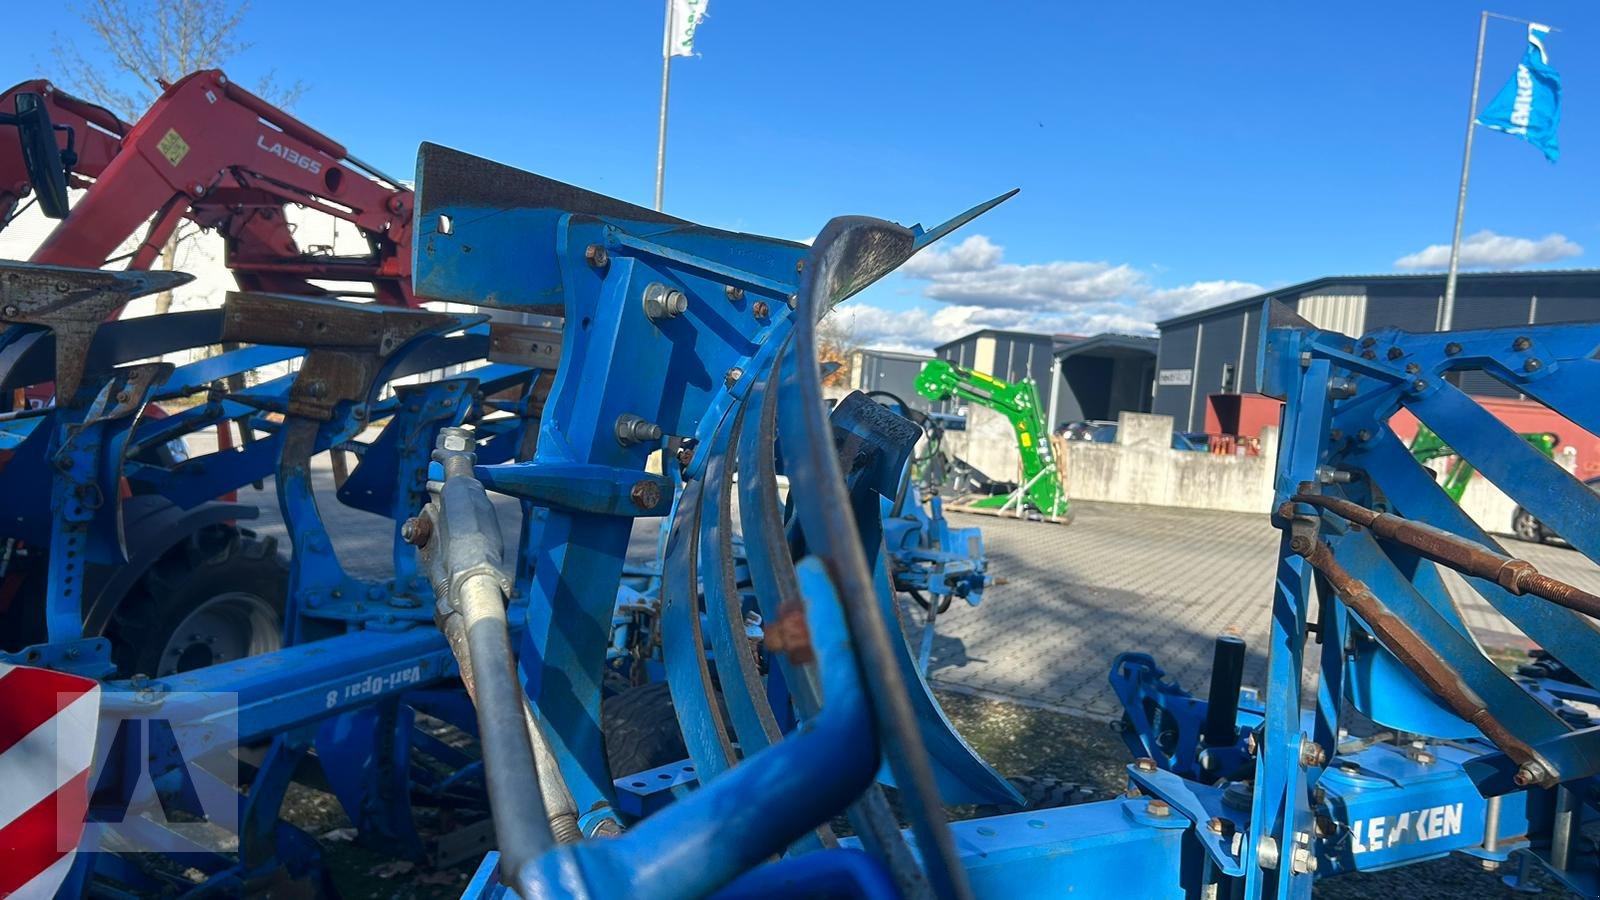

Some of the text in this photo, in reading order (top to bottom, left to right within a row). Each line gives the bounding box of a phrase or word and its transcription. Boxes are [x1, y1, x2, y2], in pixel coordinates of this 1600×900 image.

[257, 134, 322, 175] LA1365
[326, 666, 420, 708] Vari-Opal 8
